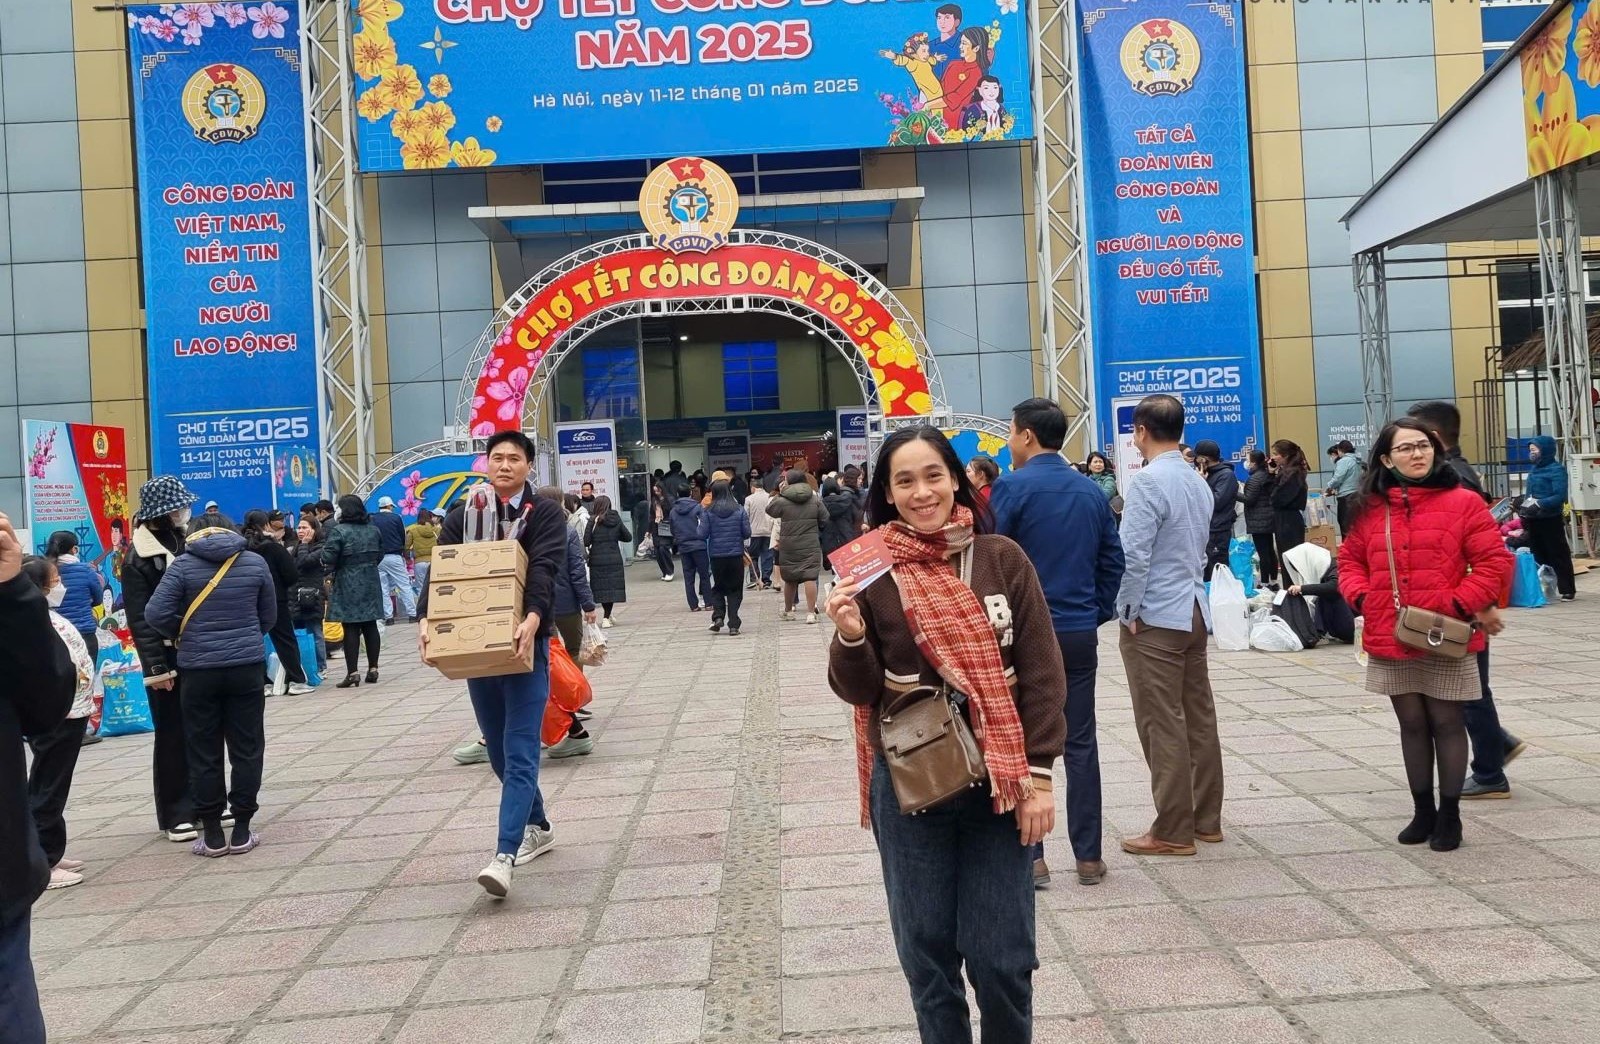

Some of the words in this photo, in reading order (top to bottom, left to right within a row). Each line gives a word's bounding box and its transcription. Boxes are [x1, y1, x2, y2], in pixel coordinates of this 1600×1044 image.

[577, 20, 689, 69] NĂM
[698, 20, 811, 63] 2025
[533, 95, 556, 108] Hà
[562, 92, 594, 108] Nội,
[602, 91, 643, 107] ngày
[650, 88, 685, 102] 11-12
[691, 84, 741, 101] tháng
[749, 83, 764, 97] 01
[771, 81, 807, 96] năm
[814, 79, 859, 93] 2025
[1149, 83, 1176, 93] CĐVN
[212, 130, 241, 140] CĐVN
[1136, 124, 1167, 144] TẤT
[1170, 124, 1195, 143] CẢ
[1120, 153, 1170, 171] ĐOÀN
[1173, 151, 1212, 169] VIÊN
[164, 183, 227, 205] CÔNG
[231, 178, 294, 202] ĐOÀN
[1116, 180, 1166, 198] CÔNG
[1170, 177, 1219, 195] ĐOÀN
[1157, 205, 1181, 223] VÀ
[175, 213, 224, 238] VIỆT
[230, 213, 285, 232] NAM,
[185, 240, 239, 264] NIỀM
[243, 244, 279, 262] TIN
[673, 236, 709, 250] CĐVN
[1096, 234, 1151, 254] NGƯỜI
[1154, 235, 1191, 250] LAO
[1194, 231, 1243, 252] ĐỘNG
[1119, 258, 1154, 278] ĐỀU
[1157, 259, 1184, 276] CÓ
[1187, 256, 1223, 276] TẾT,
[210, 271, 257, 293] CỦA
[516, 289, 573, 350] CHỢ
[572, 262, 631, 305] TẾT
[639, 258, 721, 289] CÔNG
[726, 259, 816, 297] ĐOÀN
[814, 283, 878, 337] 2025
[1136, 290, 1166, 304] VUI
[1170, 283, 1208, 302] TẾT!
[199, 301, 270, 324] NGƯỜI
[175, 337, 220, 356] LAO
[224, 332, 297, 358] ĐỘNG!
[1119, 370, 1146, 383] CHỢ
[1148, 366, 1173, 380] TẾT
[1173, 366, 1240, 390] 2025
[1119, 383, 1145, 393] CÔNG
[1146, 381, 1173, 391] ĐOÀN
[1189, 394, 1214, 405] VĂN
[1216, 393, 1240, 404] HÓA
[1205, 414, 1221, 423] HÀ
[1223, 412, 1241, 423] NỘI
[178, 421, 207, 435] CHỢ
[210, 417, 236, 432] TẾT
[237, 416, 309, 442] 2025
[178, 434, 206, 445] CÔNG
[208, 433, 236, 444] ĐOÀN
[180, 451, 212, 463] 11-12
[217, 448, 251, 459] CUNG
[218, 460, 237, 468] LAO
[239, 457, 265, 467] ĐỘNG
[181, 472, 212, 480] 01/2025
[219, 469, 244, 479] VIỆT
[246, 467, 262, 477] XÔ
